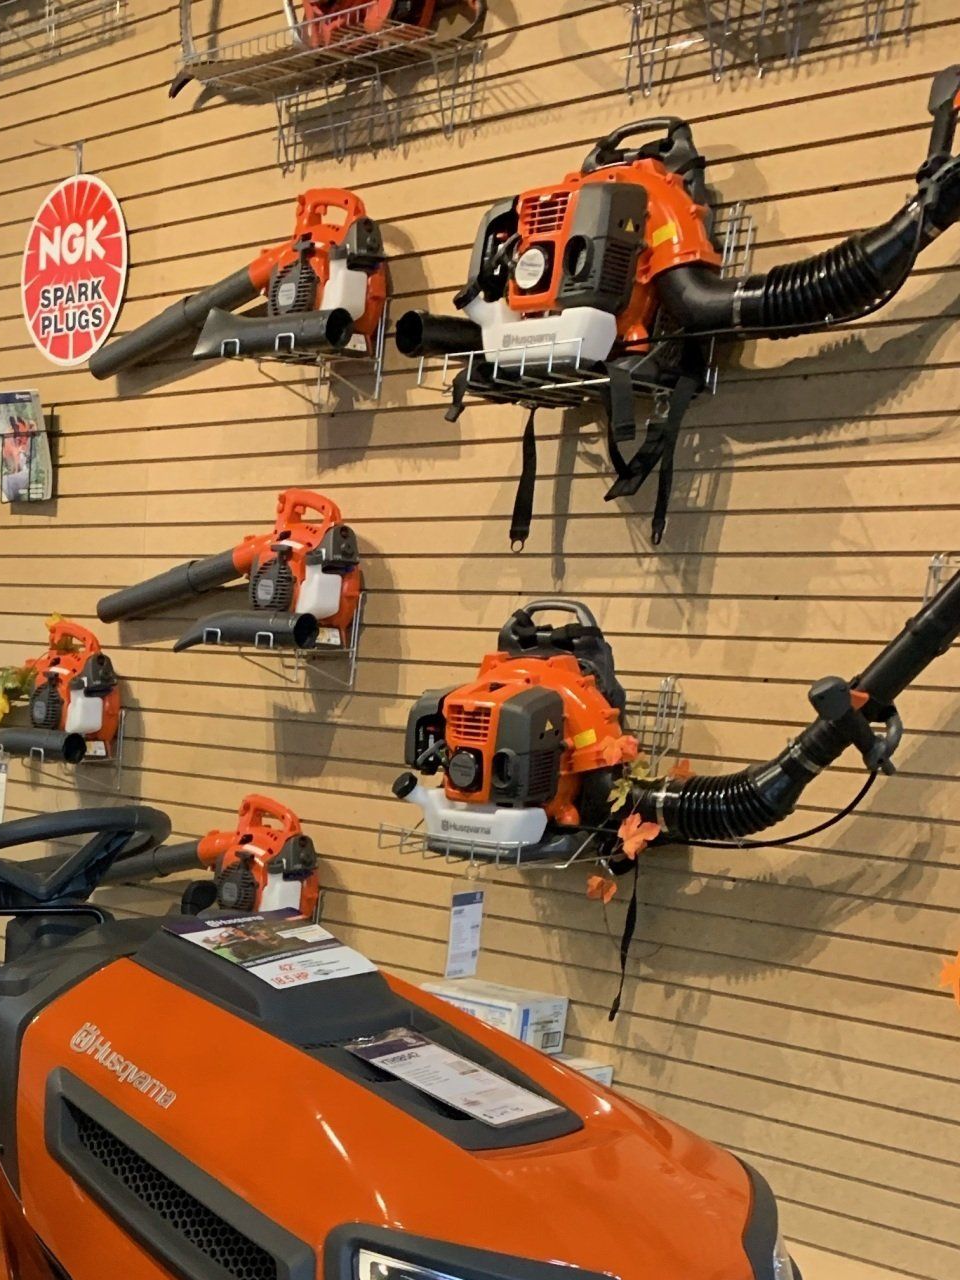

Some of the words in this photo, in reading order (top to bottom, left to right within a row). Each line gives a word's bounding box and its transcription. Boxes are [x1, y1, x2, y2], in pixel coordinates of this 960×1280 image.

[38, 214, 108, 271] NGK
[41, 279, 103, 309] SPARK
[41, 307, 103, 335] PLUGS
[511, 333, 557, 345] Husqvarna
[449, 822, 491, 835] Husqvarna
[86, 1036, 176, 1109] Husqvarna
